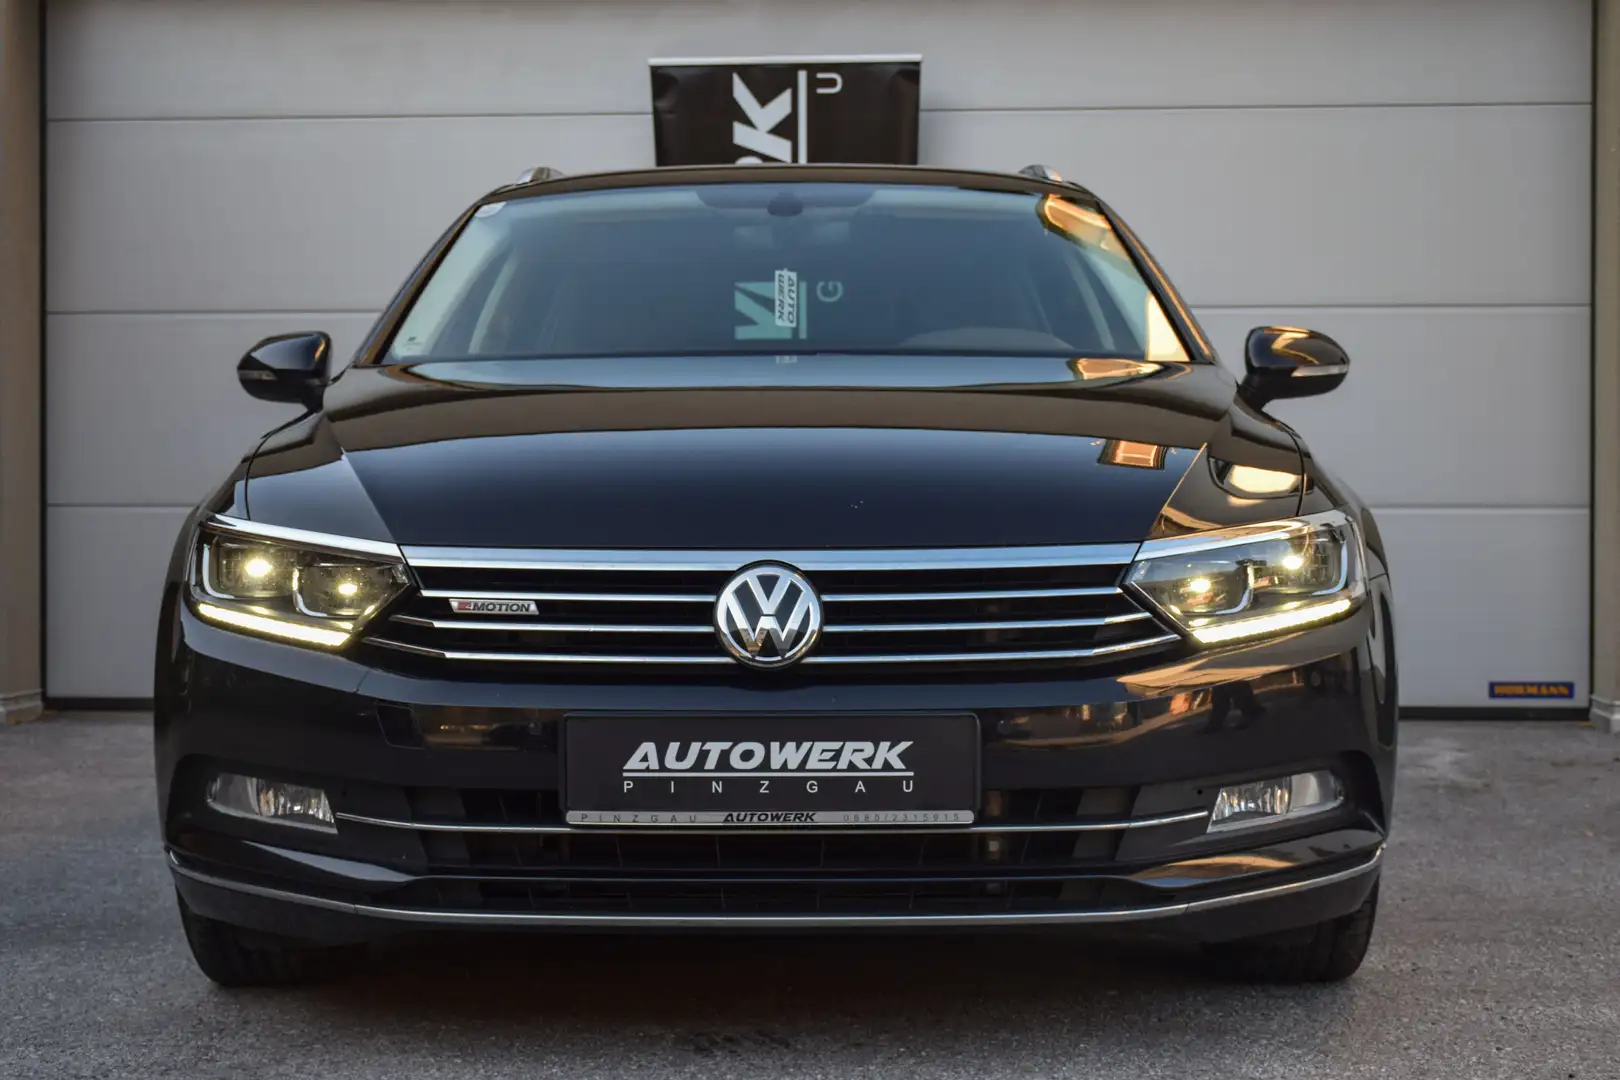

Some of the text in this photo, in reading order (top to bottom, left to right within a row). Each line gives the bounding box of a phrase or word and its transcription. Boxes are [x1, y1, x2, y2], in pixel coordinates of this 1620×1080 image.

[787, 275, 796, 324] AUTO
[622, 741, 914, 770] AUTOWERK
[623, 780, 914, 793] PINZGAU
[581, 813, 697, 823] PINZGAU
[722, 812, 816, 823] AUTOWERK
